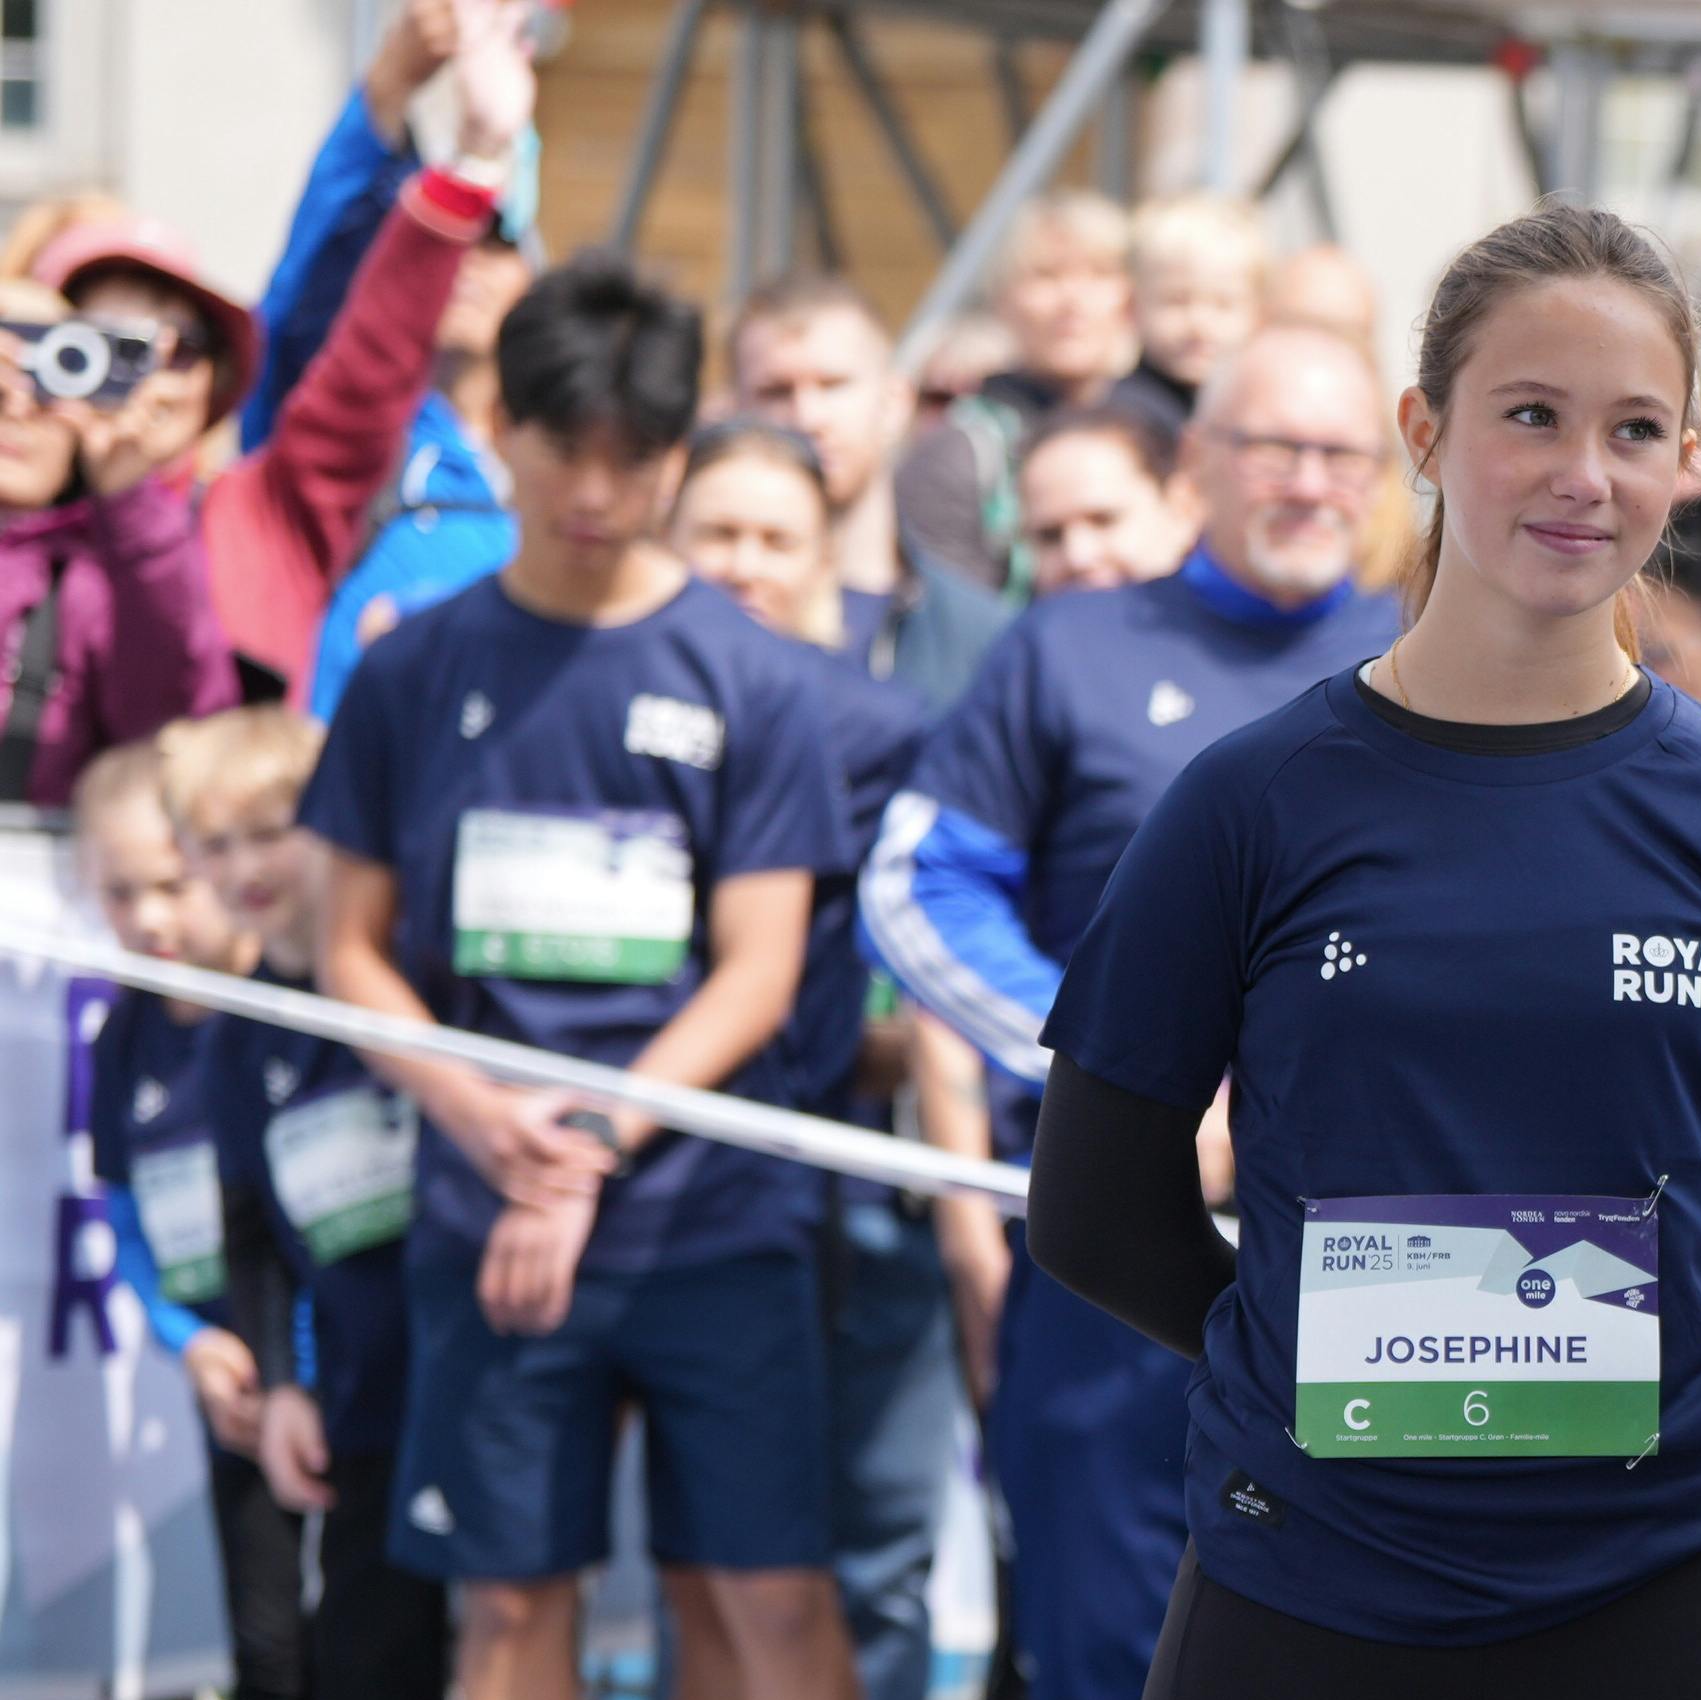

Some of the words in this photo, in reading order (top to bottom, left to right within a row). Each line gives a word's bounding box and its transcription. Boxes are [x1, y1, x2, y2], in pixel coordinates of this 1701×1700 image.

[1323, 1236, 1392, 1252] ROYAL
[1322, 1255, 1366, 1271] RUN
[1521, 1279, 1551, 1290] one
[1526, 1291, 1546, 1299] mile
[1364, 1336, 1588, 1364] JOSEPHINE
[1343, 1398, 1371, 1430] C
[1463, 1390, 1490, 1426] 6
